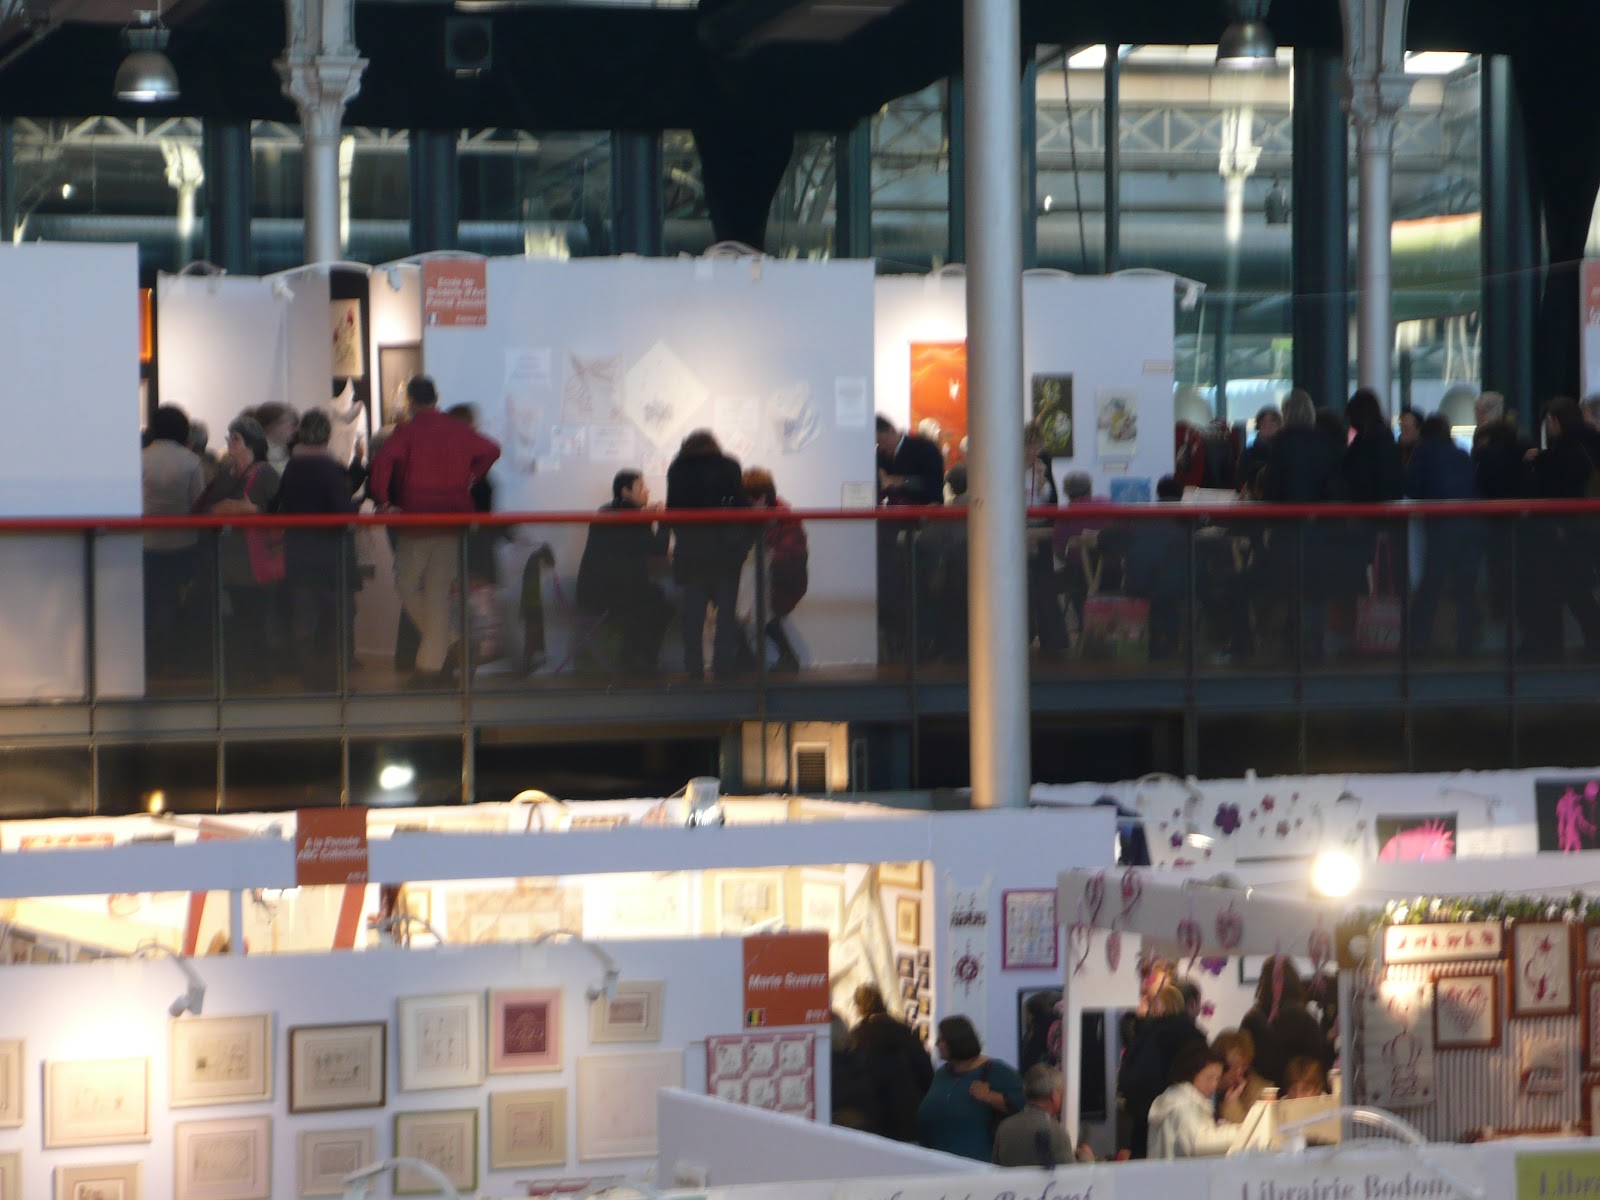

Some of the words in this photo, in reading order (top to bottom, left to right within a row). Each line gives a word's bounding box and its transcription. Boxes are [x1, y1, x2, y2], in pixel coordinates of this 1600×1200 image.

[748, 973, 783, 990] Marie
[785, 971, 826, 989] Suarez
[1241, 1177, 1355, 1200] Librairie
